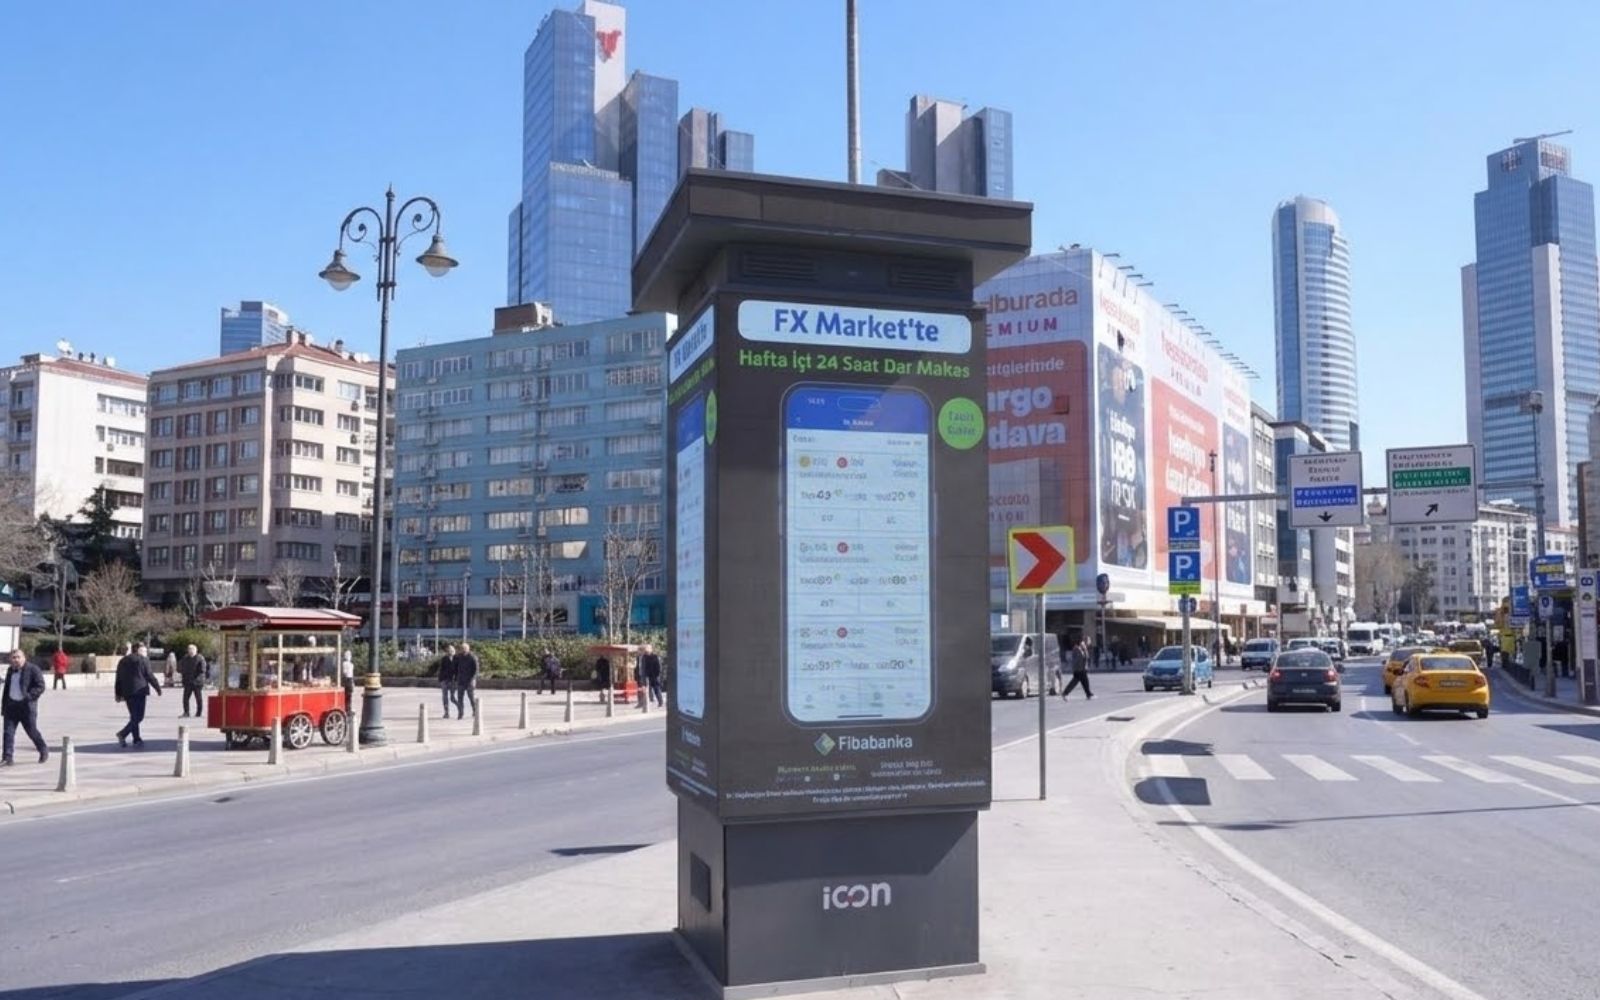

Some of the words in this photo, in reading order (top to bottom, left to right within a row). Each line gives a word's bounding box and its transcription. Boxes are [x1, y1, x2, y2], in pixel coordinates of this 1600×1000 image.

[774, 308, 808, 334] FX
[815, 311, 939, 342] Market'te
[739, 349, 787, 368] Hafta
[816, 354, 838, 370] 24
[842, 356, 879, 374] Saat
[884, 358, 912, 375] Dar
[1174, 510, 1191, 533] P
[1175, 555, 1193, 579] P
[838, 734, 913, 750] Fibabanka
